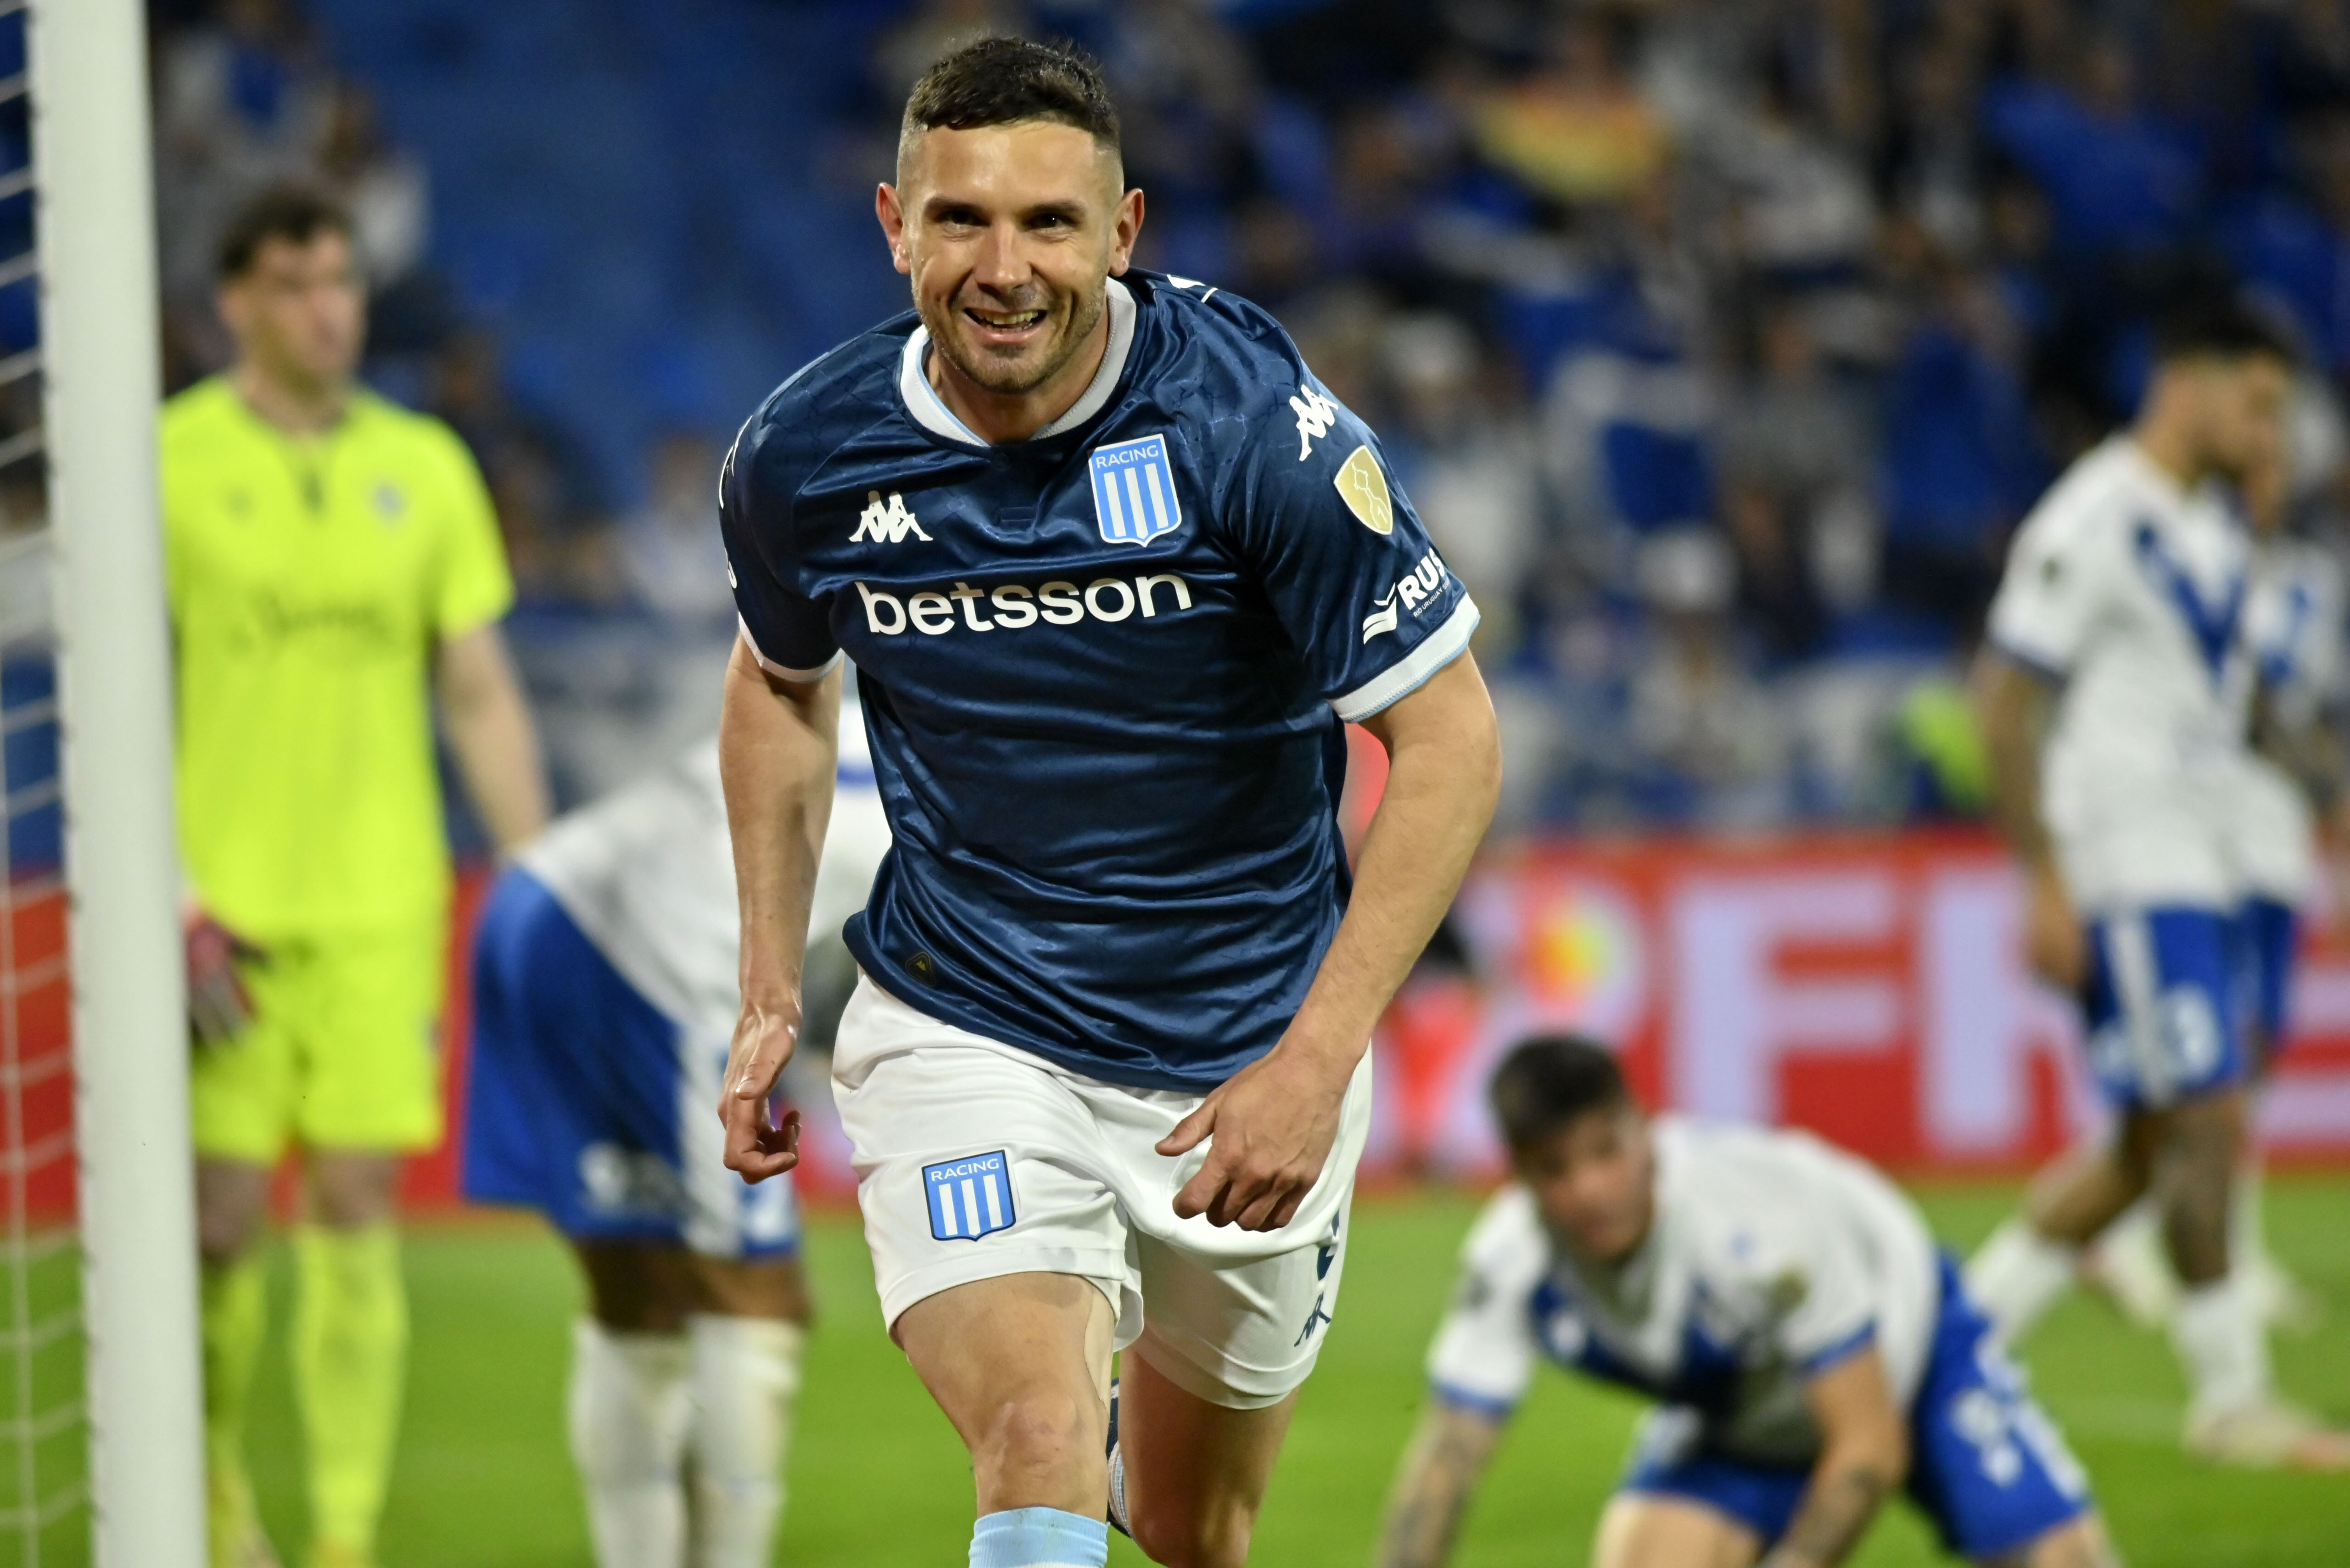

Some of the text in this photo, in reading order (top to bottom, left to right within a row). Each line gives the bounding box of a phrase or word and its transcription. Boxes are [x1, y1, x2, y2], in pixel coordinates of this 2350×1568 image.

[1095, 445, 1159, 469] RACING
[1397, 546, 1445, 610] RUS
[854, 574, 1192, 636] betsson
[1413, 607, 1422, 618] RIO
[1422, 587, 1444, 610] URUGUAY
[930, 1158, 1000, 1182] RACING
